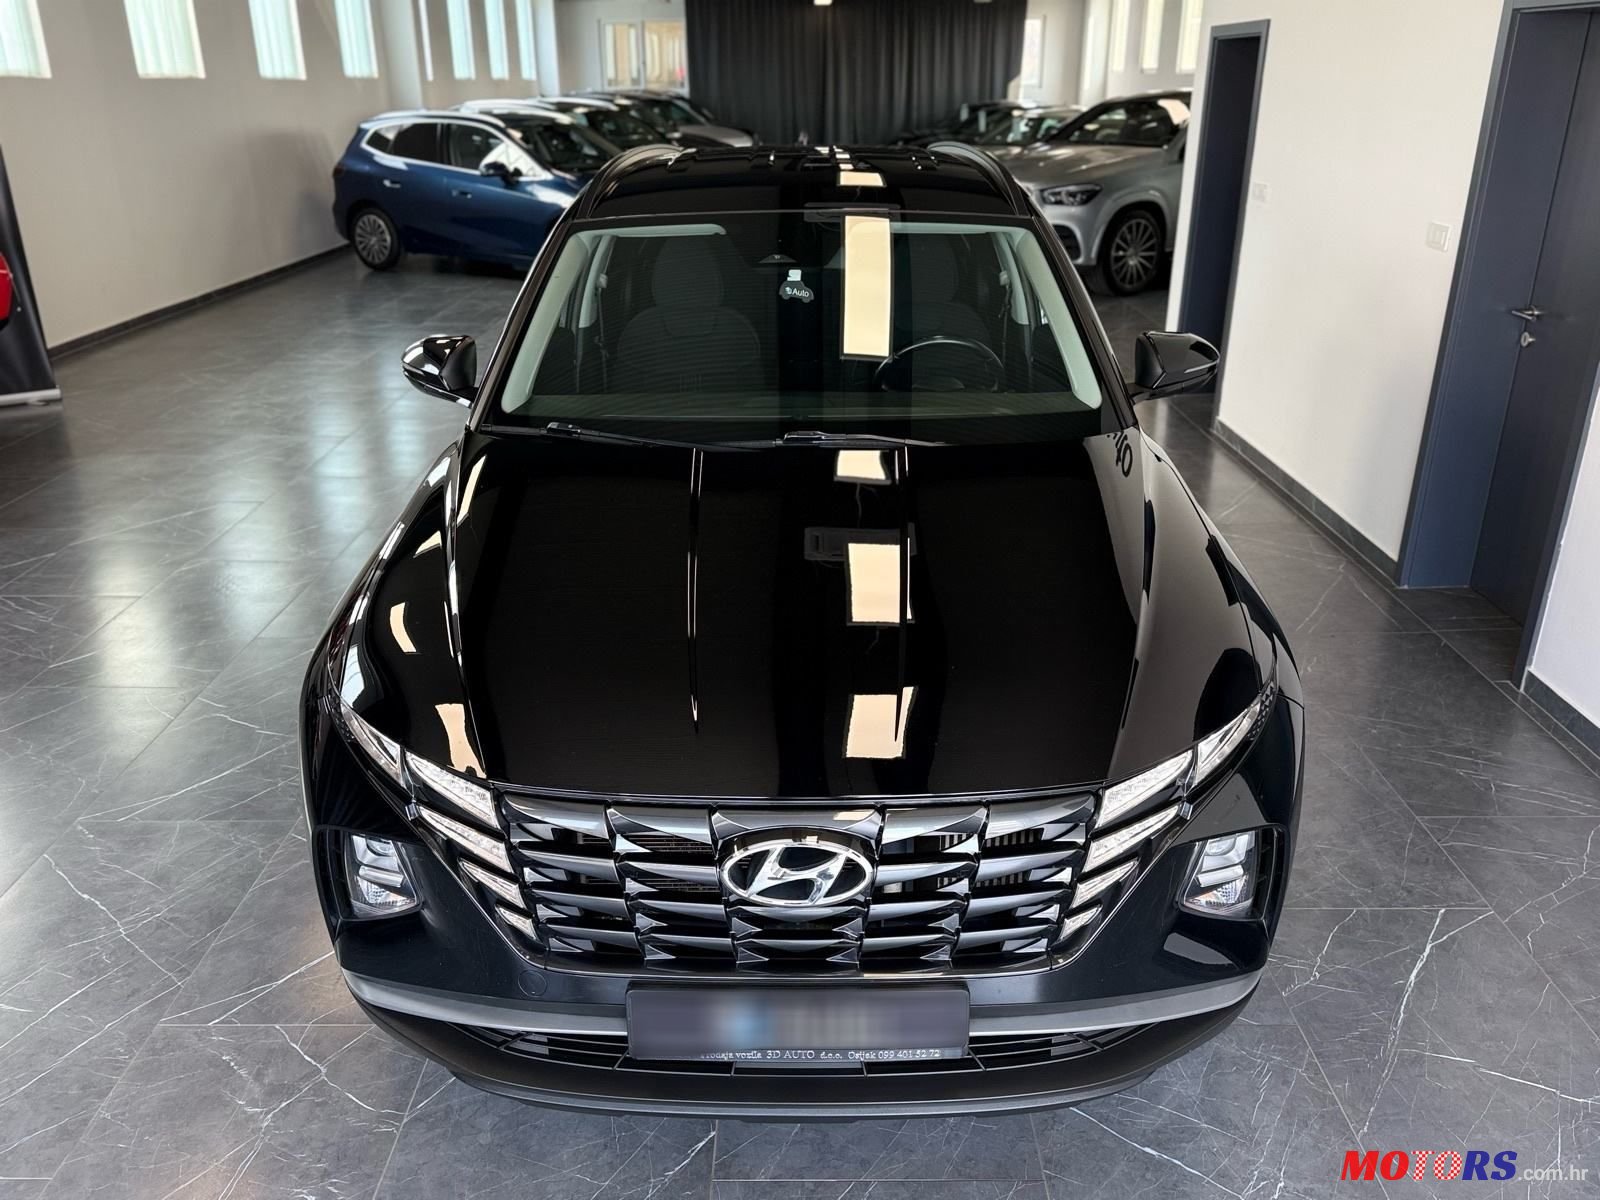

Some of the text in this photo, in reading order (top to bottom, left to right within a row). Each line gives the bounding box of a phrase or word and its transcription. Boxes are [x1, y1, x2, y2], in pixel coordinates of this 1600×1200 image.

[766, 1049, 781, 1059] 3D
[783, 1049, 815, 1059] AUTO
[877, 1049, 895, 1059] 099
[896, 1049, 913, 1059] 401
[928, 1048, 941, 1058] 72
